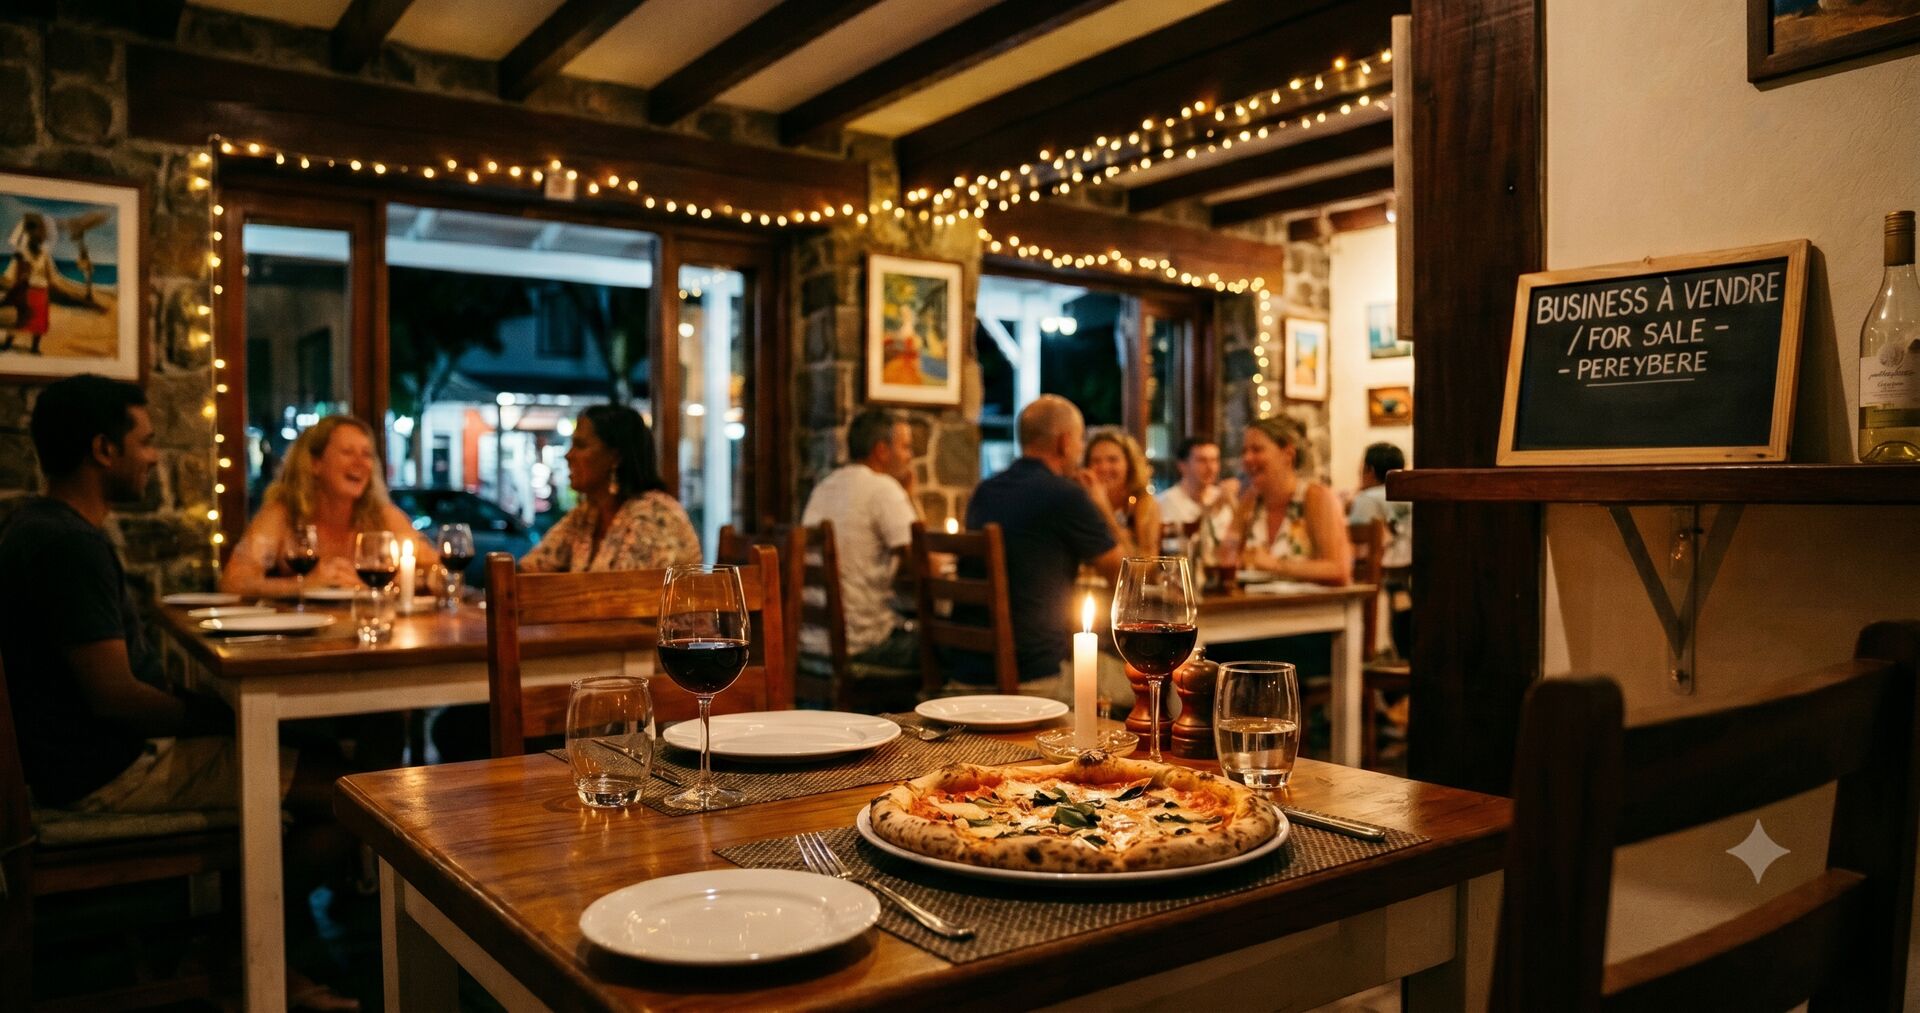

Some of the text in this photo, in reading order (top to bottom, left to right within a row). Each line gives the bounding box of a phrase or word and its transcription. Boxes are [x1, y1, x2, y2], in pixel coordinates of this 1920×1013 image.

[1536, 271, 1780, 324] BUSINESS À VENDRE
[1642, 318, 1706, 347] SALE
[1577, 351, 1708, 380] PEREYBERE
